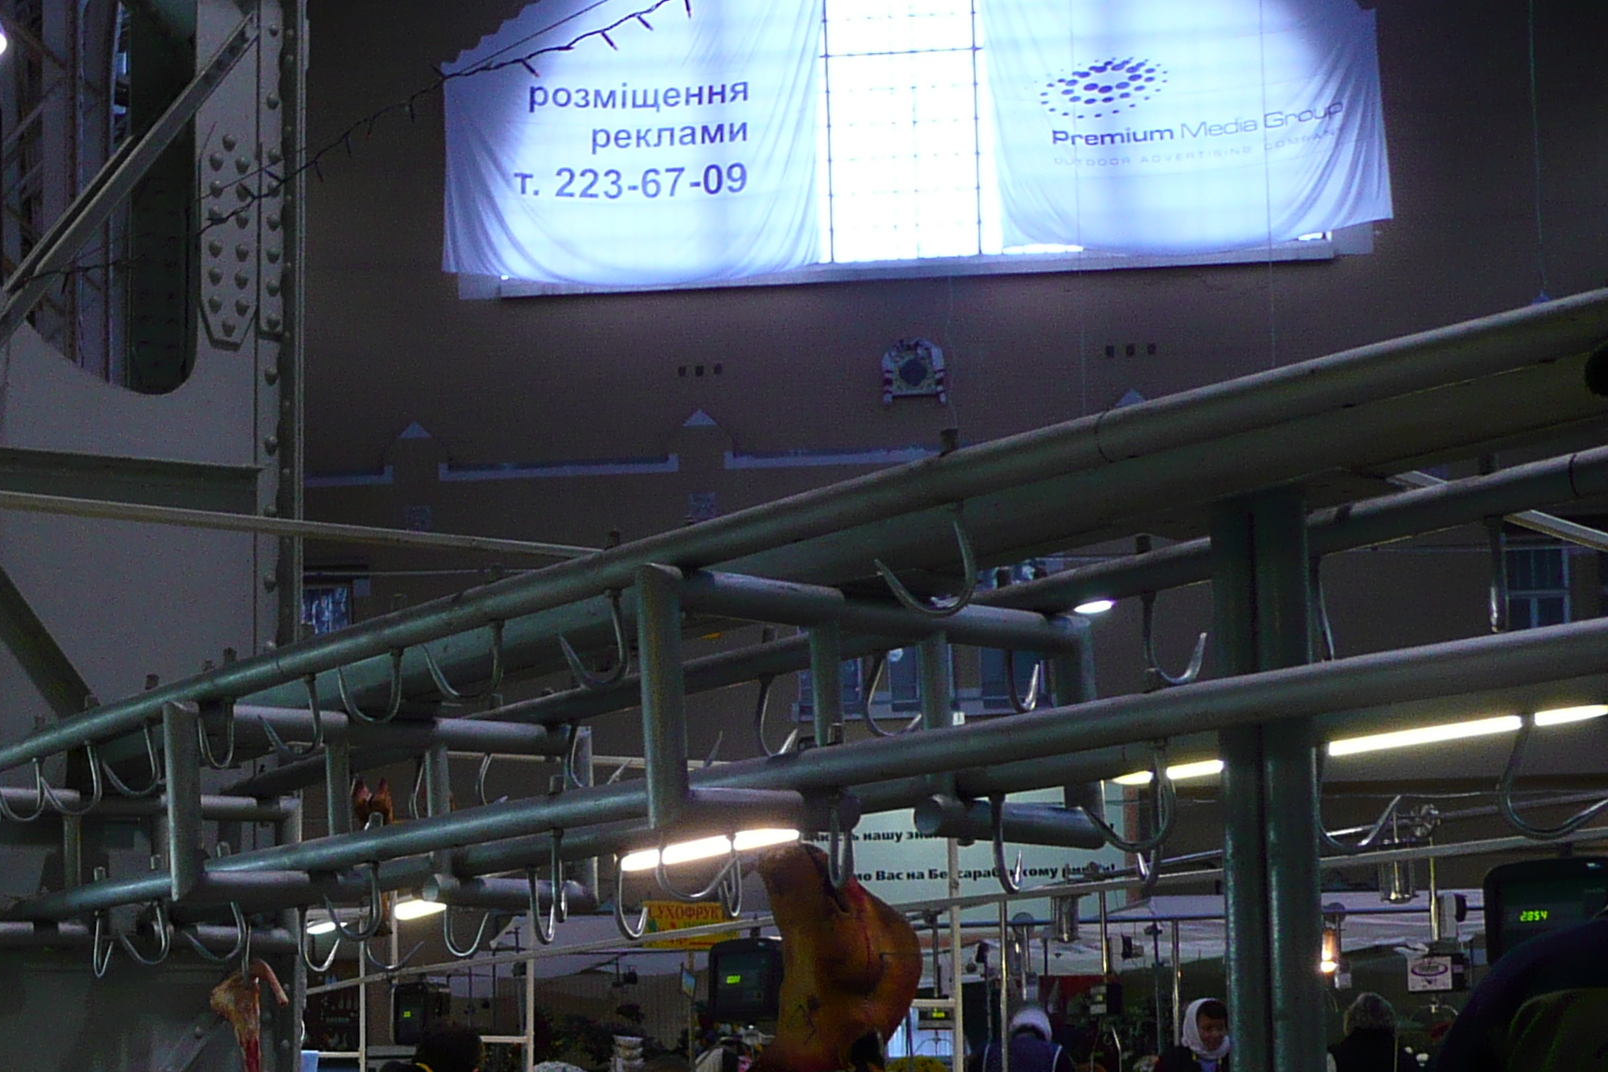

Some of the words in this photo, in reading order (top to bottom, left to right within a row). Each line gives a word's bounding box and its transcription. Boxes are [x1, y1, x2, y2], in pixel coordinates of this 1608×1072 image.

[529, 81, 749, 113] розміщення
[592, 121, 748, 155] реклами
[1052, 127, 1174, 146] Premium
[1180, 117, 1258, 139] Media
[1263, 102, 1342, 129] Group
[1054, 156, 1131, 167] OUTDOOR
[1140, 145, 1252, 164] ADVERTISING
[513, 171, 540, 196] т.
[554, 162, 748, 199] 223-67-09
[863, 831, 903, 844] нашу
[876, 869, 903, 881] Вас
[905, 870, 925, 881] на
